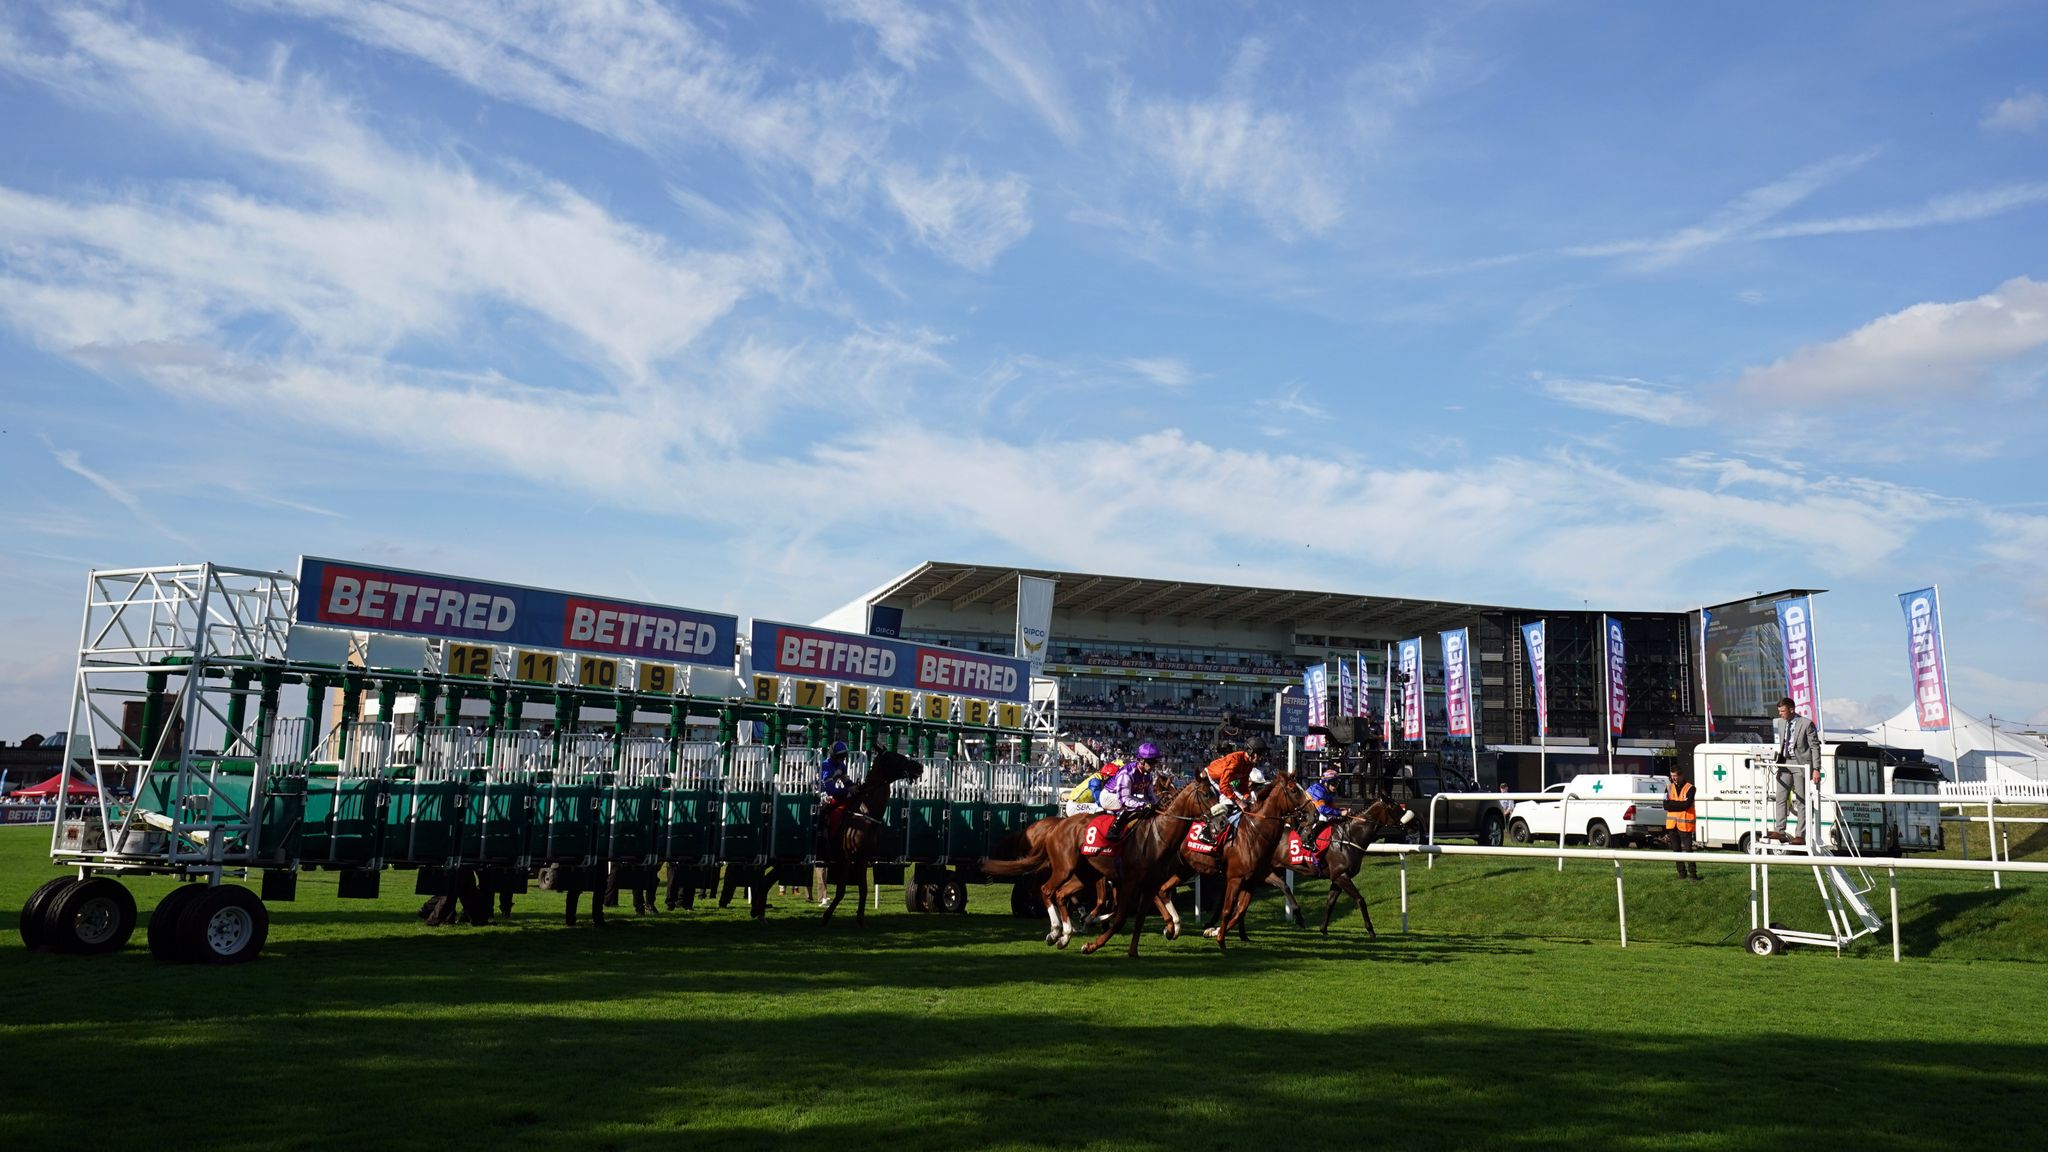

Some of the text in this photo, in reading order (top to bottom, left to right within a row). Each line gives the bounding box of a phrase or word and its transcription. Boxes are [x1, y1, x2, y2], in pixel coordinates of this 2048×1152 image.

[327, 576, 516, 632] BETFRED
[570, 607, 717, 656] BETFRED
[453, 646, 489, 676] 12
[522, 653, 553, 682] 11
[781, 636, 896, 678] BETFRED
[583, 660, 615, 686] 10
[650, 666, 665, 690] 9
[920, 655, 1018, 693] BETFRED
[757, 678, 770, 701] 8
[805, 683, 817, 705] 7
[848, 688, 859, 710] 6
[893, 693, 904, 714] 5
[932, 698, 942, 718] 3
[971, 702, 982, 722] 2
[1283, 696, 1308, 706] BETFRED
[1007, 706, 1014, 726] 1
[1086, 826, 1098, 845] 8
[1189, 824, 1203, 841] 3
[1290, 839, 1300, 855] 5
